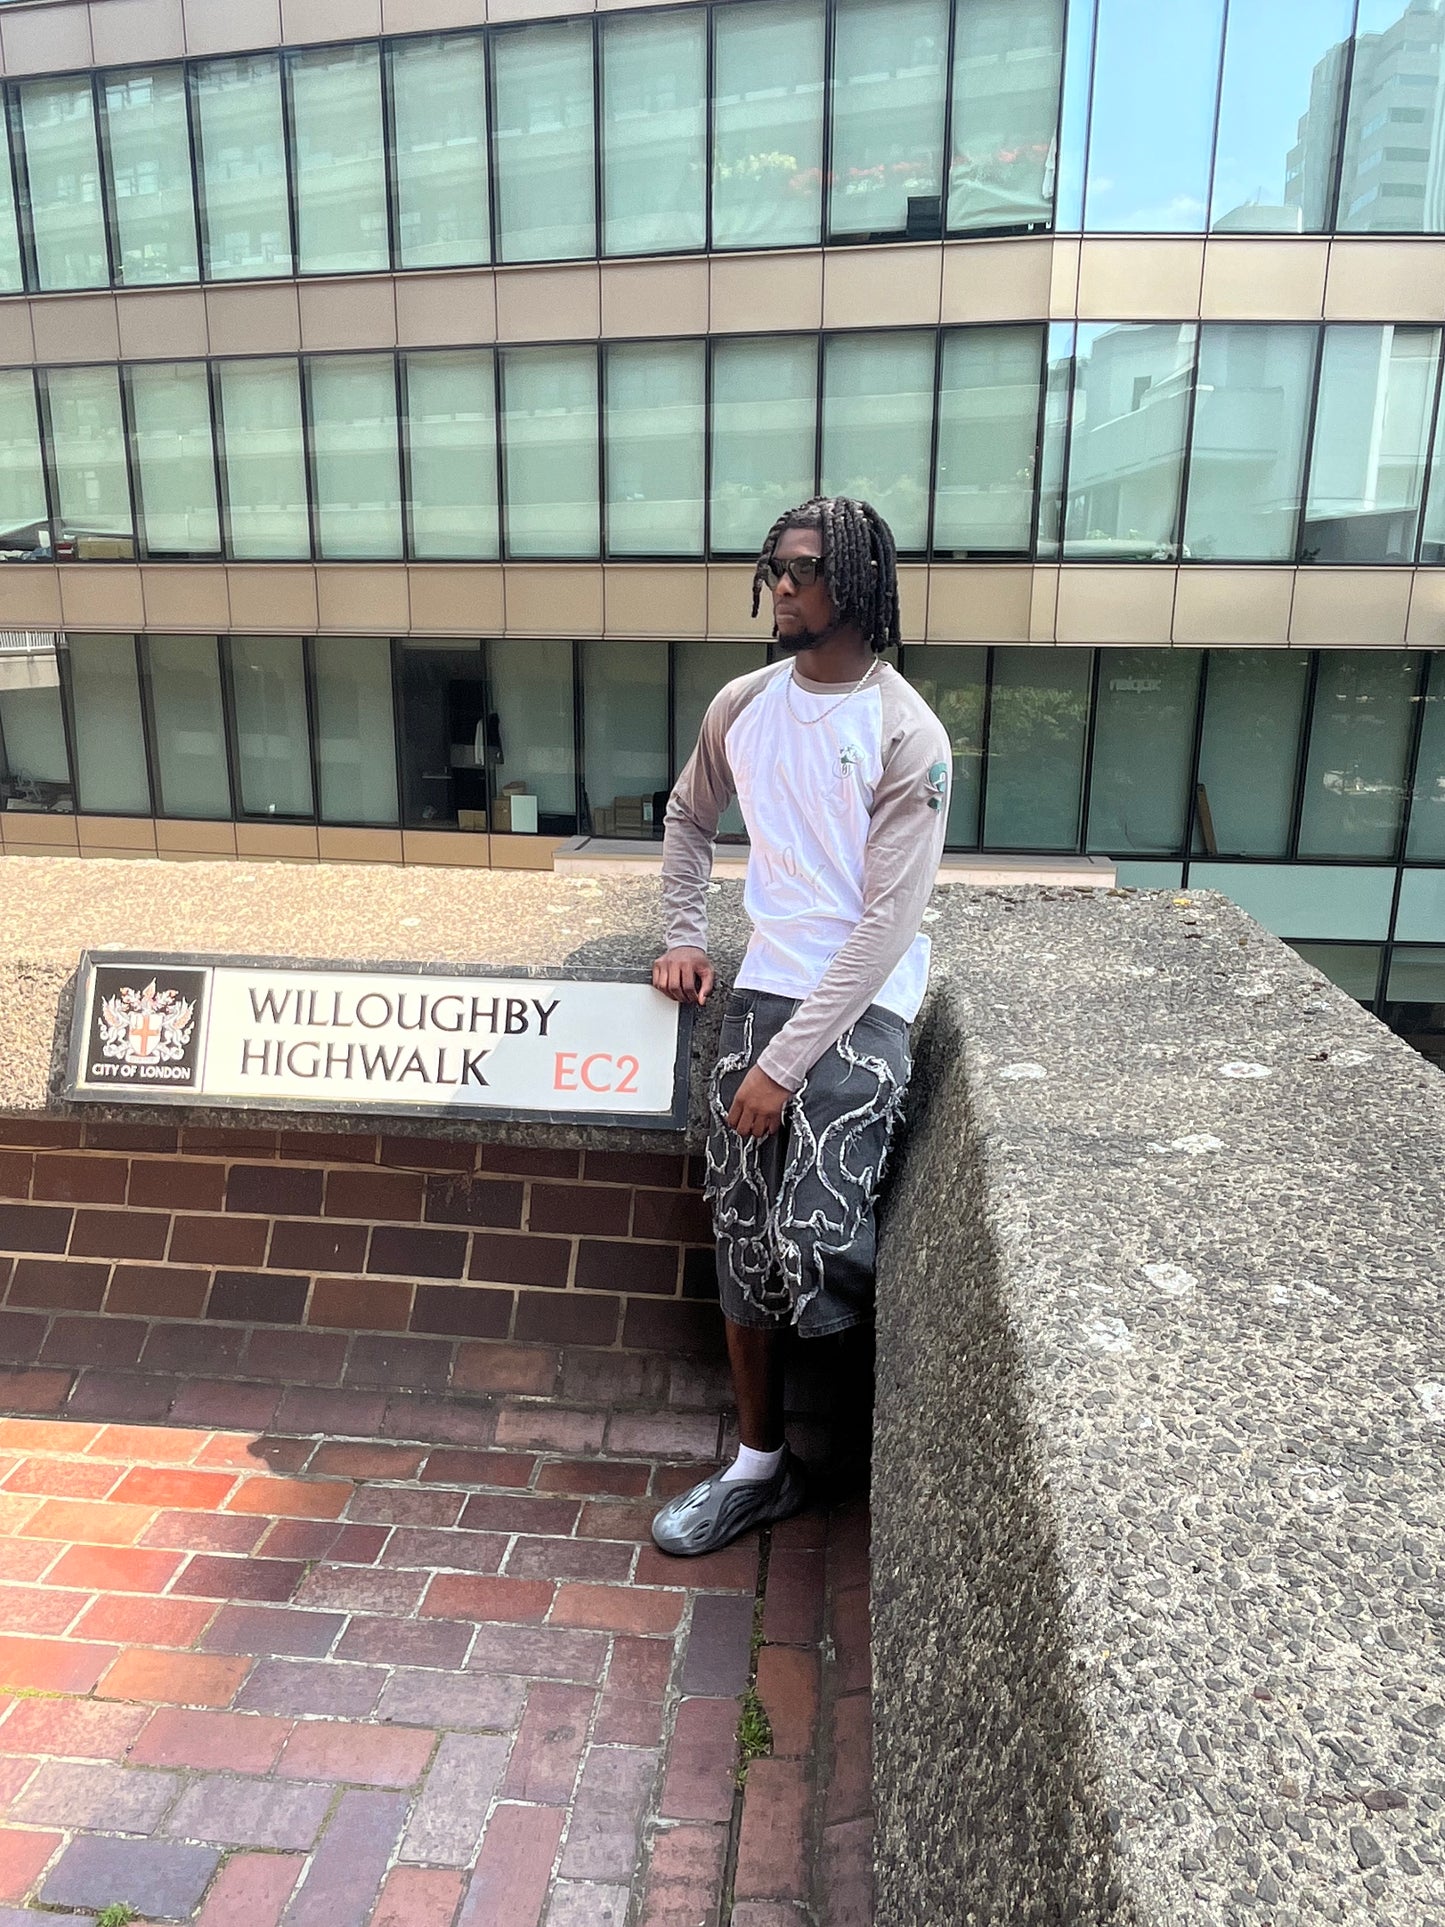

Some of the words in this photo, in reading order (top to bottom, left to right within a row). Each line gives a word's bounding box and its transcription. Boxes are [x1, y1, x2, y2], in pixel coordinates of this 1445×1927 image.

[249, 987, 560, 1036] WILLOUGHBY
[92, 1063, 119, 1077] CITY
[120, 1065, 137, 1077] OF
[140, 1065, 191, 1080] LONDON
[240, 1039, 490, 1086] HIGHWALK
[553, 1052, 640, 1093] EC2
